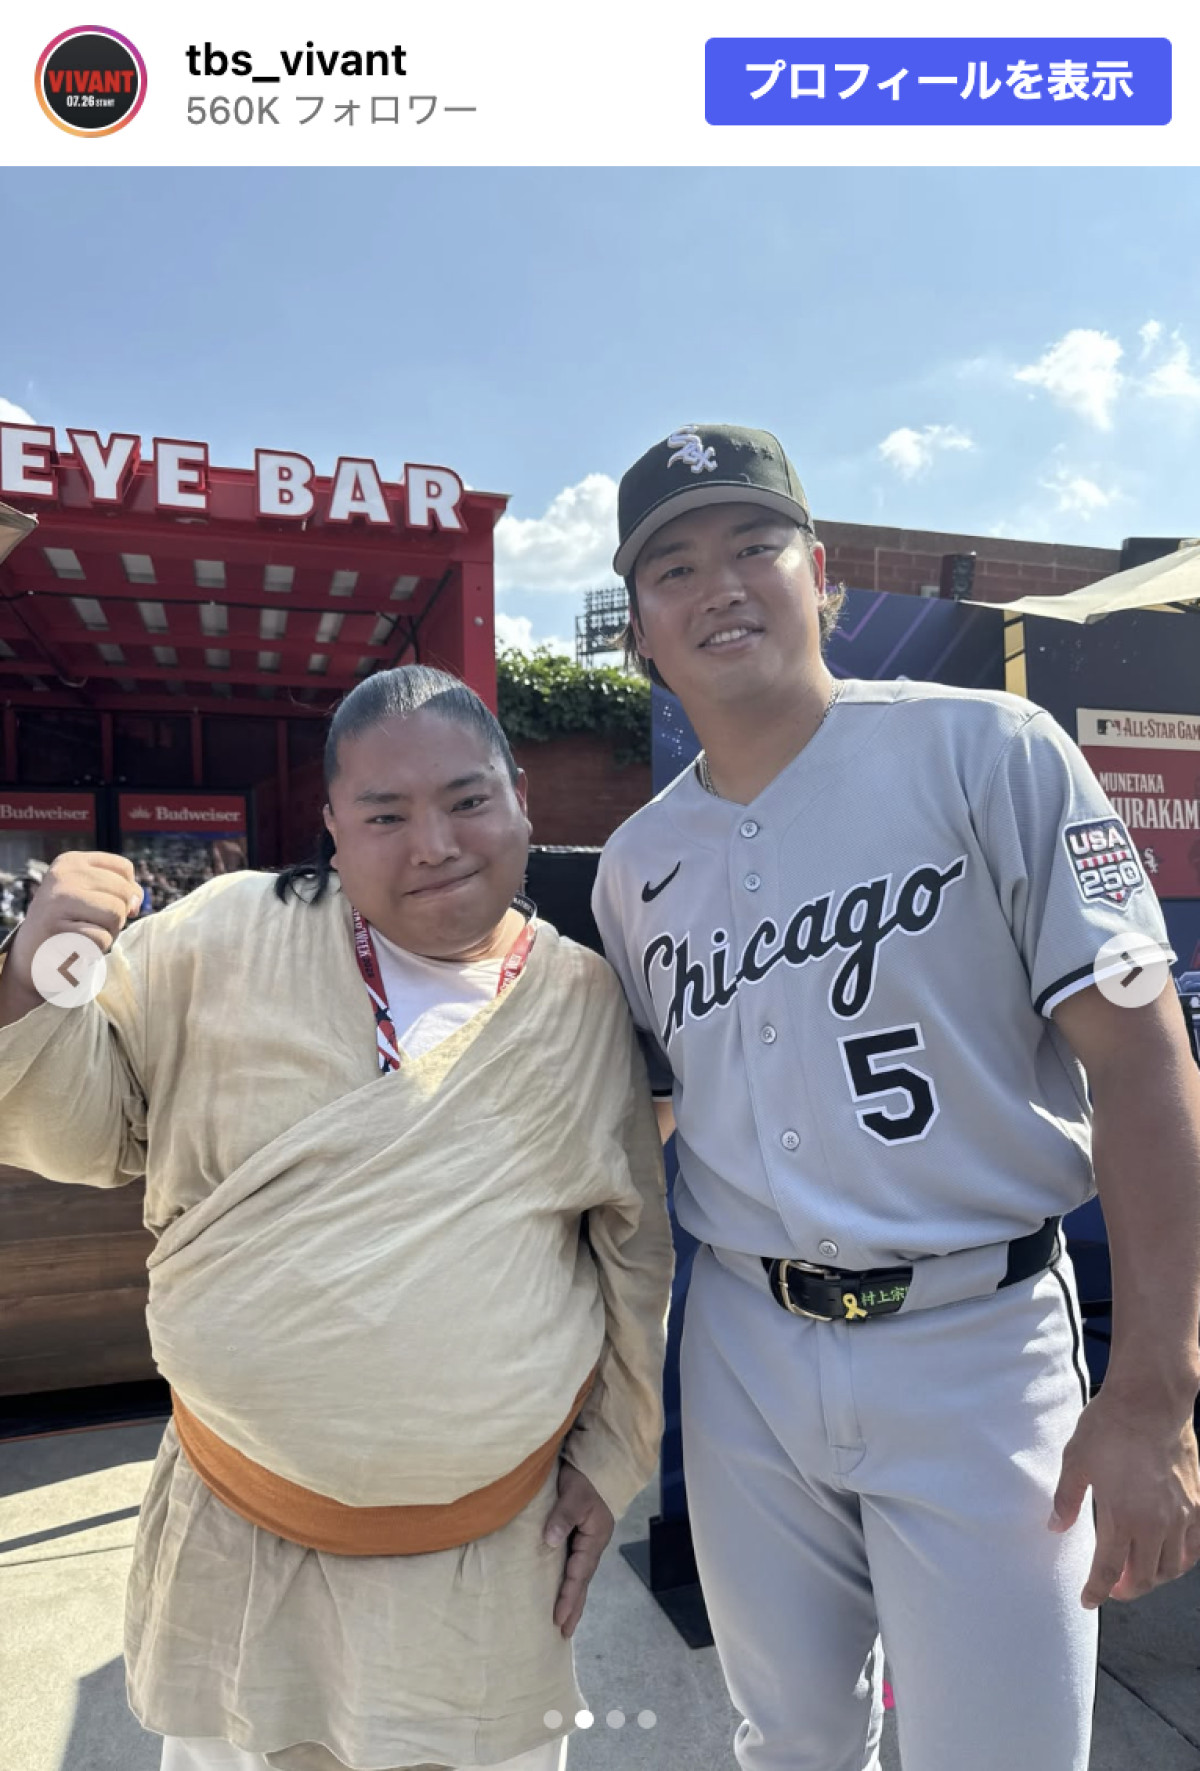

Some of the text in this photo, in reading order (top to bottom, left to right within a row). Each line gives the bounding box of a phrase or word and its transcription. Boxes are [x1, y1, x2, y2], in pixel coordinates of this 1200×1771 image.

[0, 424, 466, 532] EYE BAR
[1099, 772, 1165, 794] MUNETAKA
[0, 804, 89, 821] Budweiser
[156, 806, 241, 822] Budweiser
[1110, 797, 1200, 830] URAKAM
[1069, 826, 1126, 855] USA
[1080, 861, 1142, 896] 250
[643, 854, 968, 1053] Chicago
[837, 1022, 941, 1147] 5
